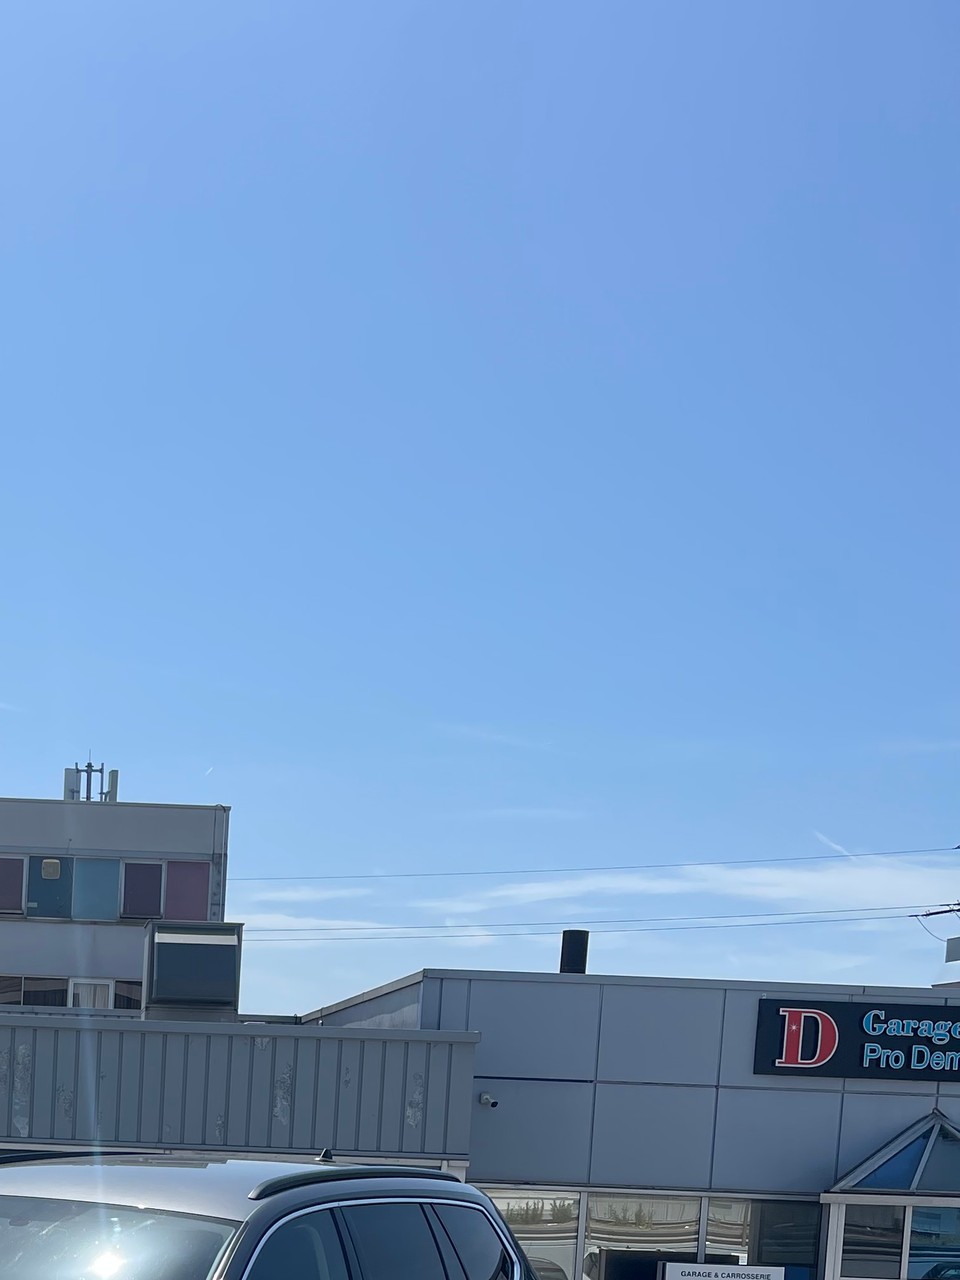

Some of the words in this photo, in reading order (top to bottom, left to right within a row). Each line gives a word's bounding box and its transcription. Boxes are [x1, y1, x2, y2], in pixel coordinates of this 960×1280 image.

[775, 1007, 839, 1068] D
[862, 1010, 960, 1045] Garage
[862, 1043, 905, 1070] Pro
[911, 1044, 960, 1071] Dem
[680, 1270, 712, 1278] GARAGE
[721, 1272, 772, 1280] CARROSSERIE
